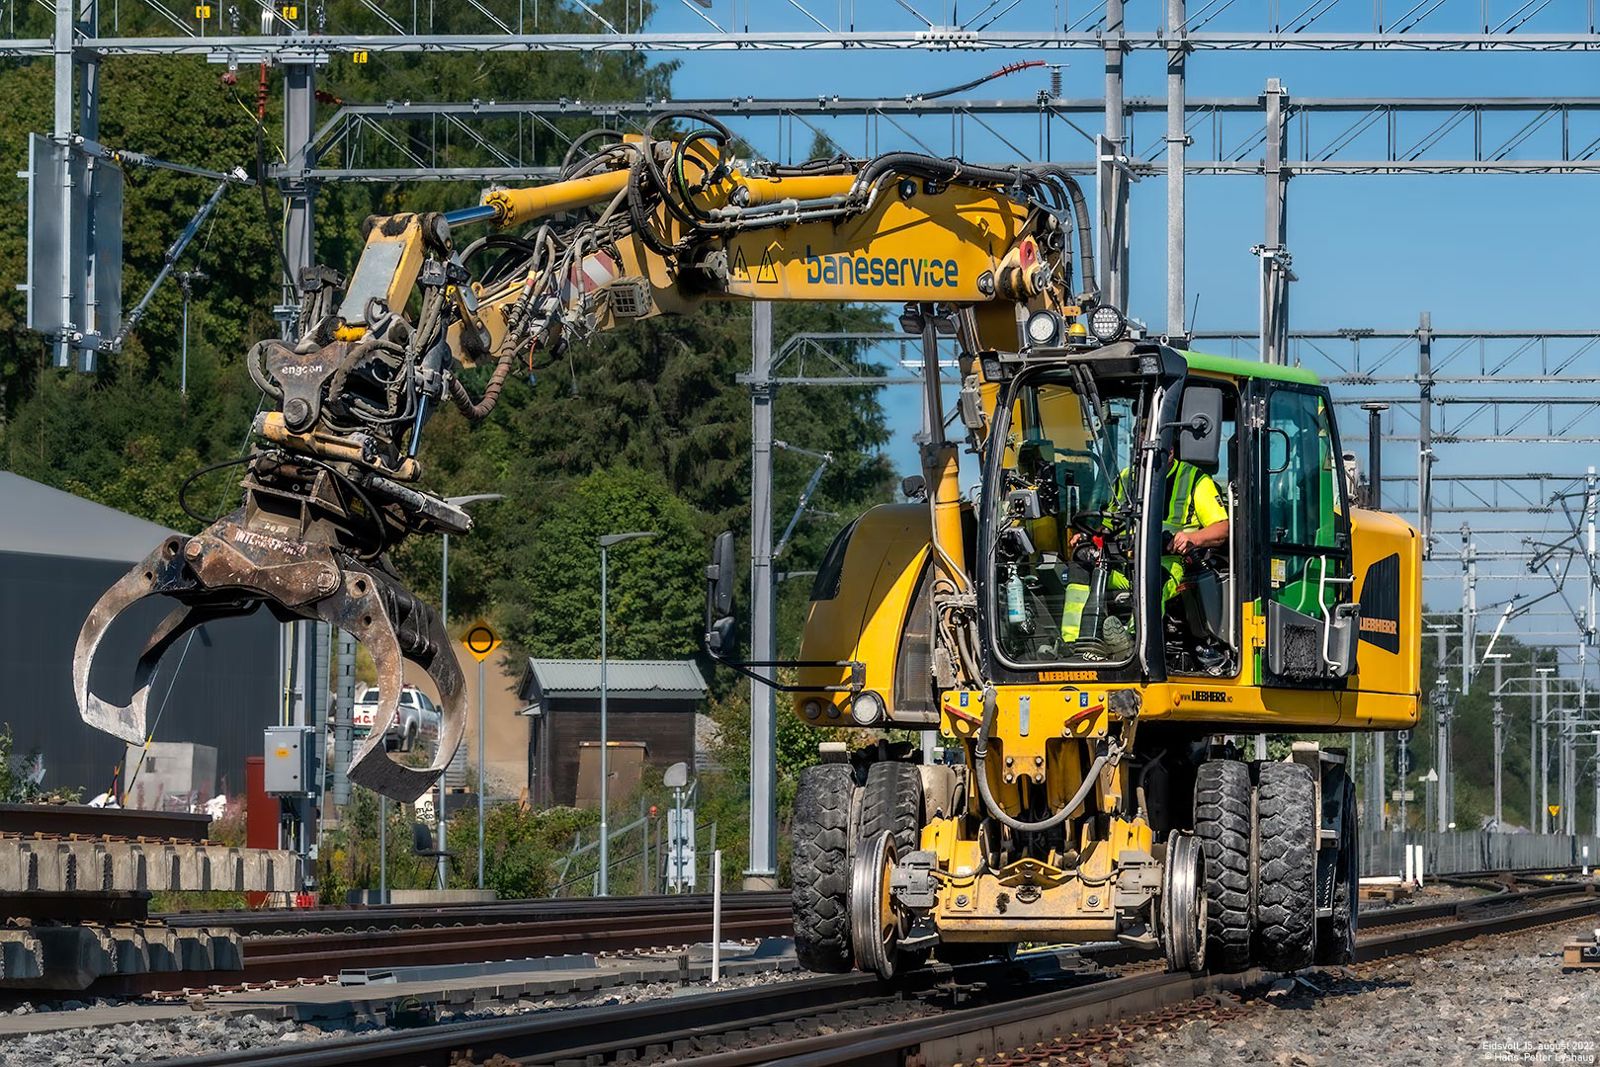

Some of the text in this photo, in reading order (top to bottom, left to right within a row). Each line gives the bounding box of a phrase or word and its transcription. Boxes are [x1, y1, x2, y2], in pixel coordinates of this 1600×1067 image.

[806, 244, 959, 288] baneservice
[281, 364, 323, 377] engcon
[1359, 616, 1397, 635] LIEBHERR
[1038, 671, 1099, 681] LIEBHERR
